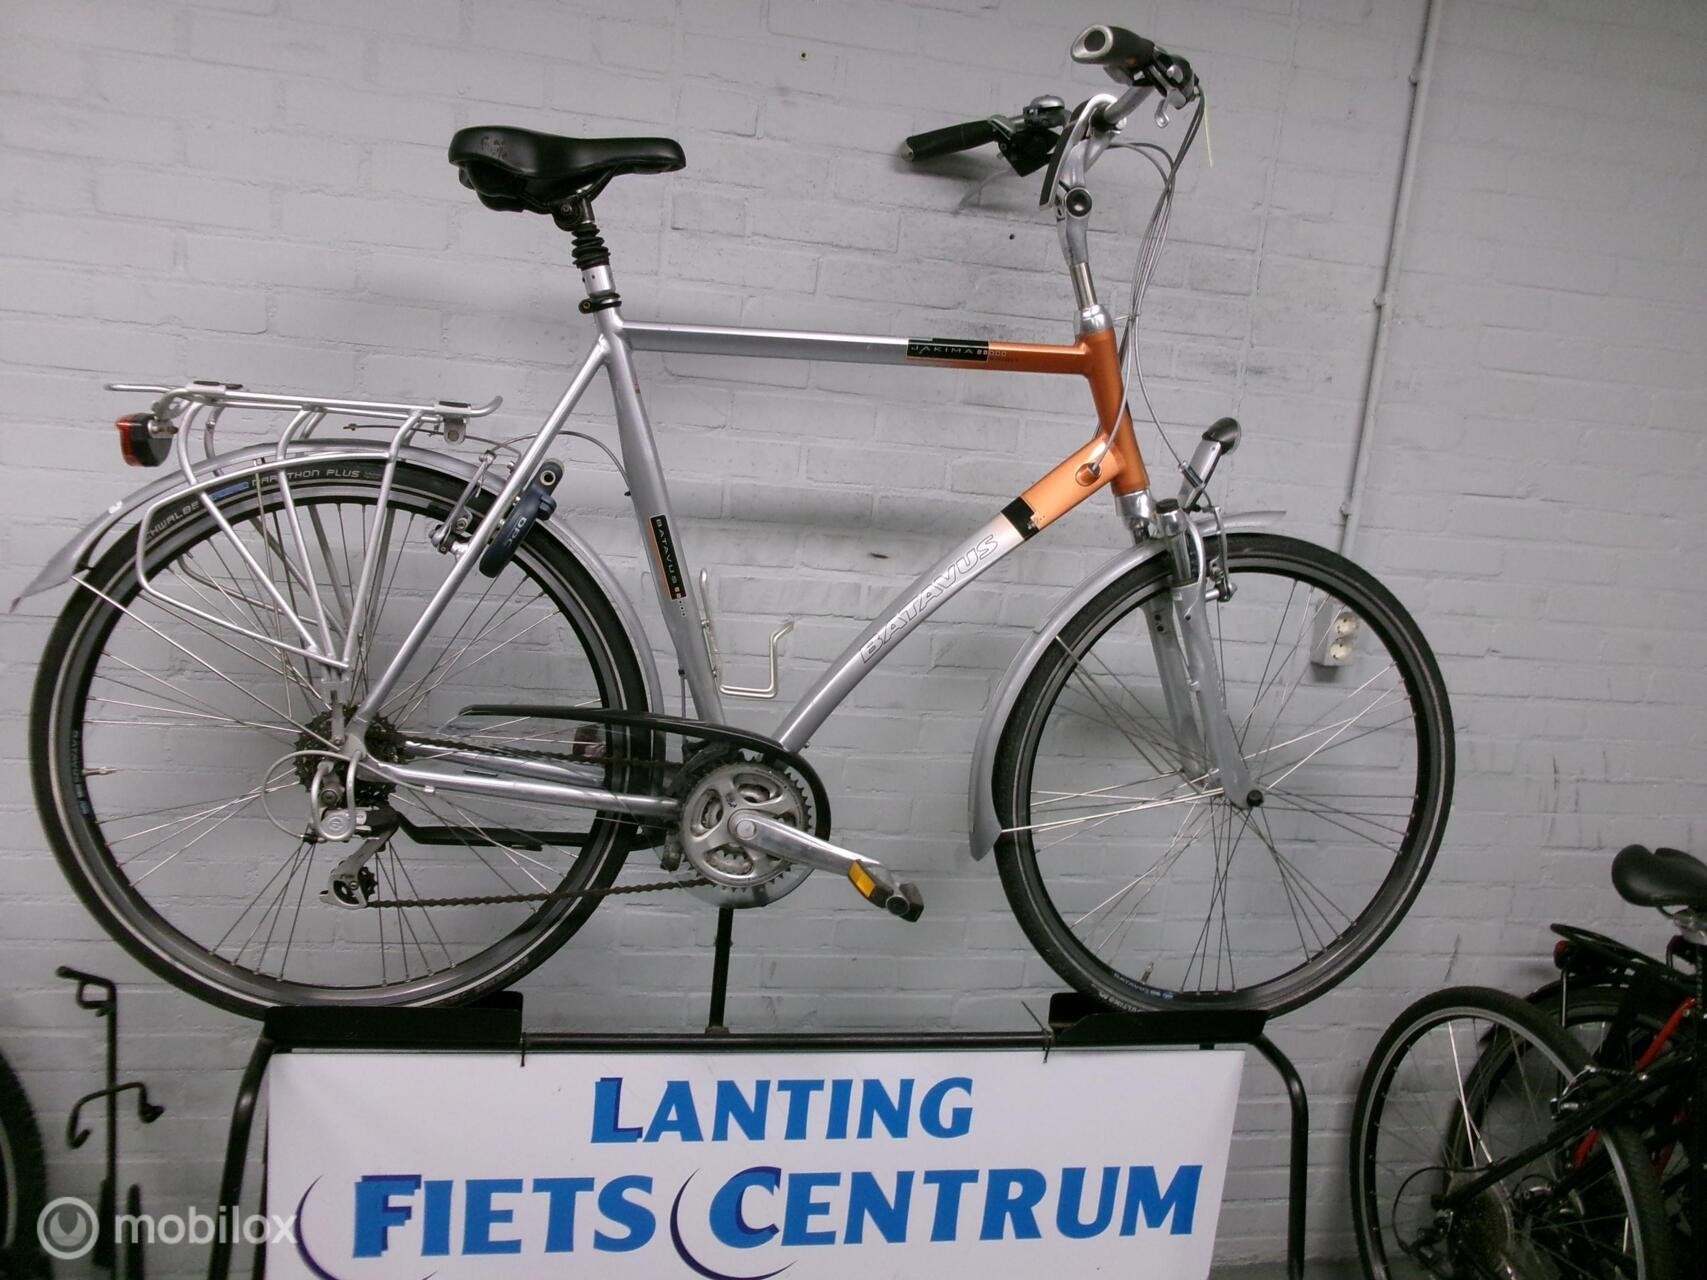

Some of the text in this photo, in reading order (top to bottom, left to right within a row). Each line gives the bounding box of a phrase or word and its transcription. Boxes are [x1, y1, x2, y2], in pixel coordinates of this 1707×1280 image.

[326, 469, 360, 478] PLUS
[656, 519, 677, 583] BATAVUS
[859, 534, 998, 663] BATAVUS
[591, 1077, 973, 1145] LANTING
[353, 1165, 1203, 1258] FIETS CENTRUM
